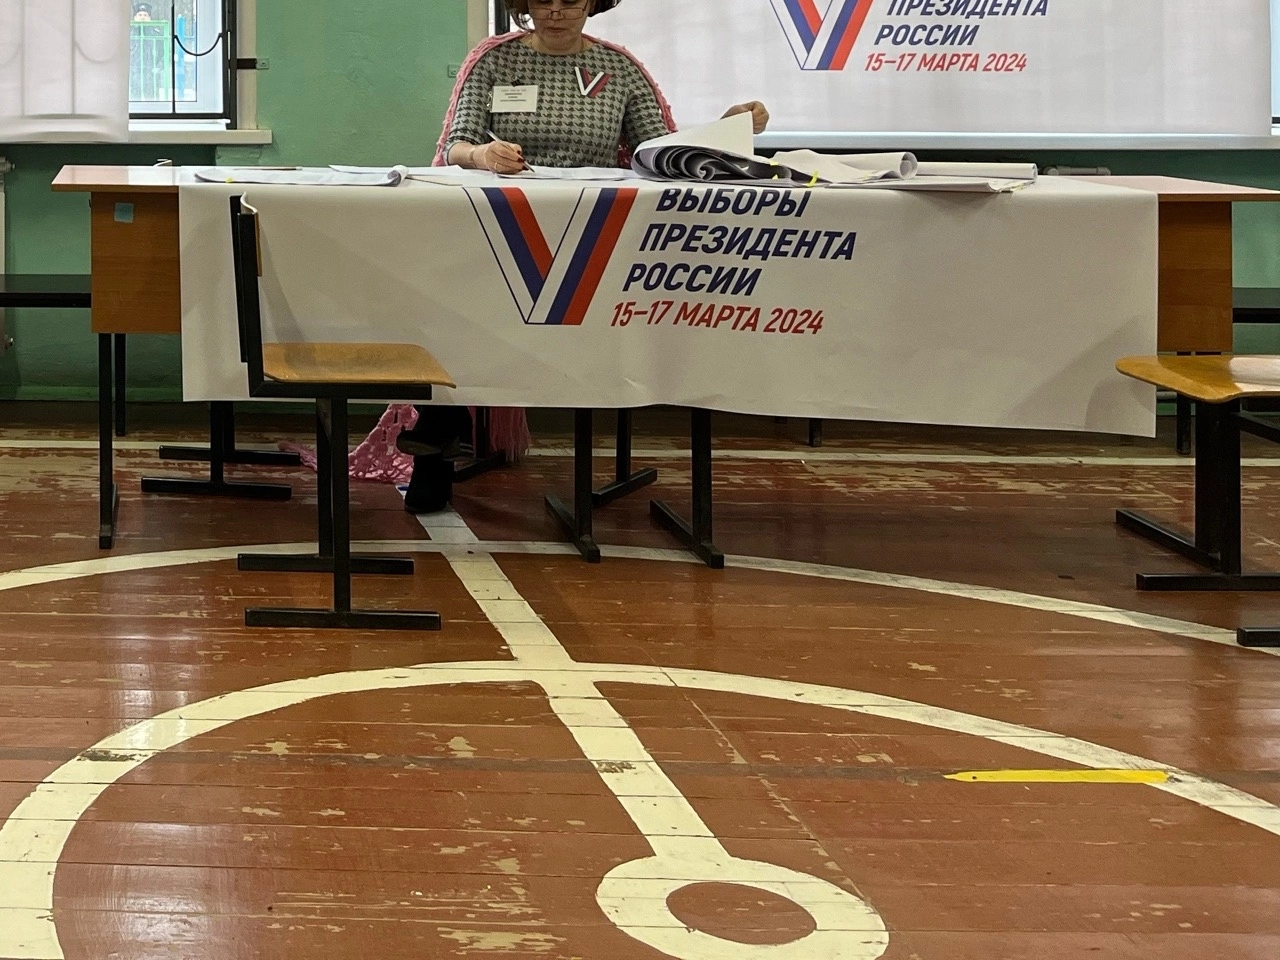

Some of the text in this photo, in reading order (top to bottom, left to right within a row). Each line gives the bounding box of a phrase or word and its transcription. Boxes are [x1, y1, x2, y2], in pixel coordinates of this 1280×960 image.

[874, 24, 980, 46] РОССИИ
[917, 53, 980, 72] МАРТА
[982, 53, 1028, 72] 2024
[655, 188, 812, 218] ВЫБОРЫ
[638, 223, 857, 261] ПРЕЗИДЕНТА
[622, 262, 762, 296] РОССИИ
[673, 301, 761, 332] МАРТА
[763, 307, 825, 335] 2024
